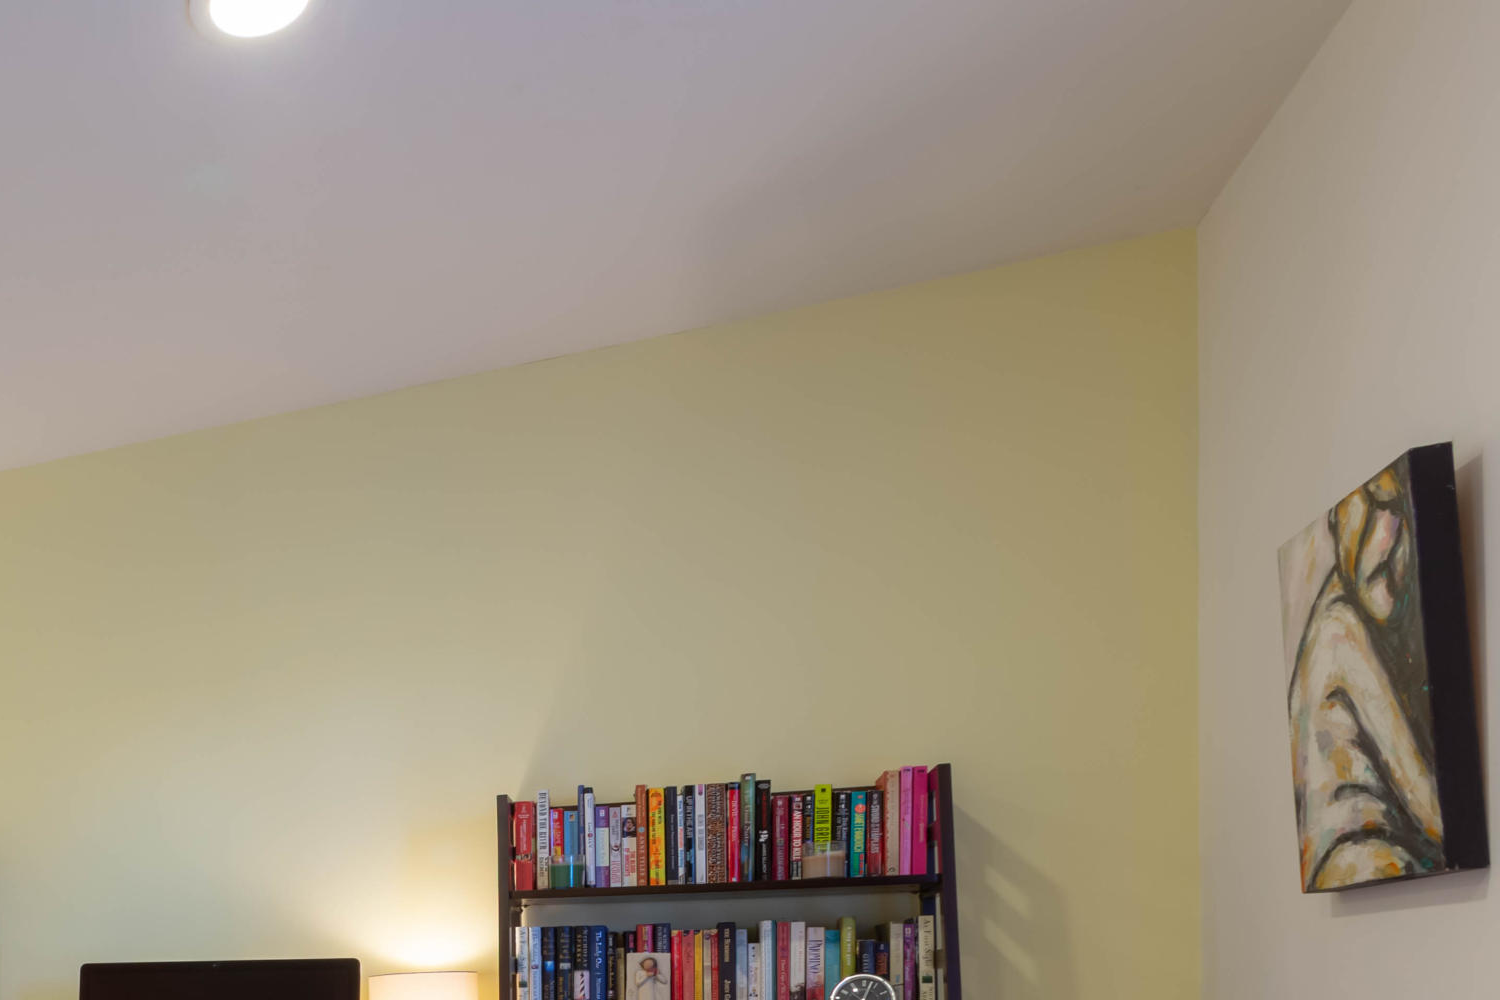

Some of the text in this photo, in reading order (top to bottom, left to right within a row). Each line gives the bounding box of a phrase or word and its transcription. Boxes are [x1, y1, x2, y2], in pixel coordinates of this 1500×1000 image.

[539, 792, 548, 816] BEYOND
[539, 818, 548, 829] THE
[817, 807, 830, 823] JOHN
[539, 832, 548, 850] RIVER
[794, 810, 802, 860] AN HOUR TO KILL
